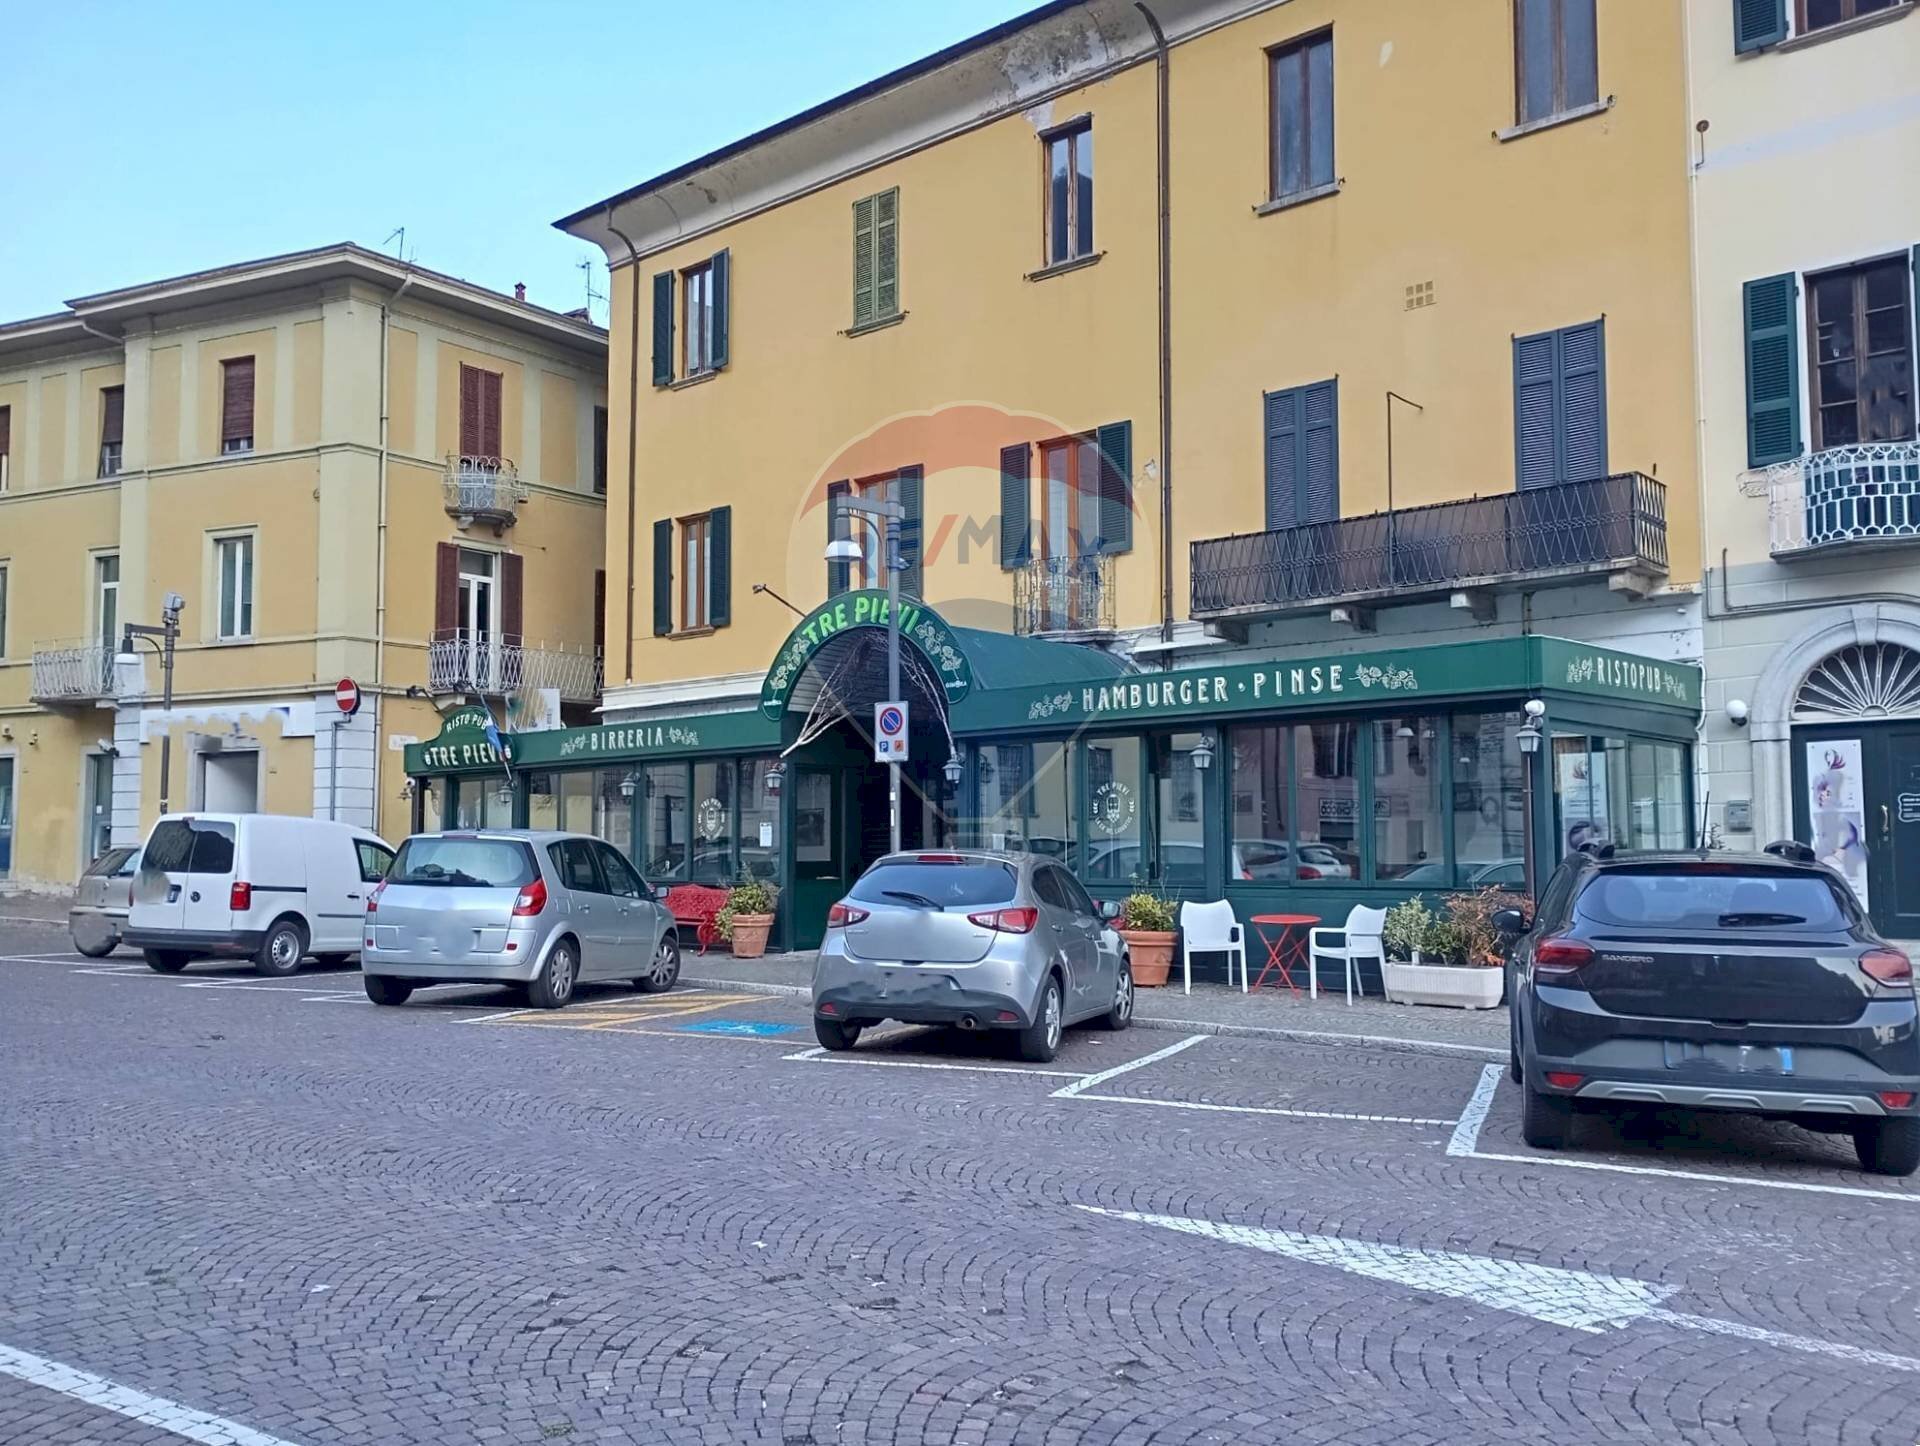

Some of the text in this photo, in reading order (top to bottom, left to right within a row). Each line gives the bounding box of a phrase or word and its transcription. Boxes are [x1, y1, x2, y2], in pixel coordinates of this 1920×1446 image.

[802, 597, 920, 645] TRE PIEVI
[1597, 657, 1661, 693] RISTOPUB
[1082, 665, 1344, 712] HAMBURGER PINSE
[446, 713, 488, 733] RISTO PUB
[591, 727, 664, 751] BIRRERIA
[430, 745, 459, 767] TRE
[1601, 954, 1655, 963] SANDERO
